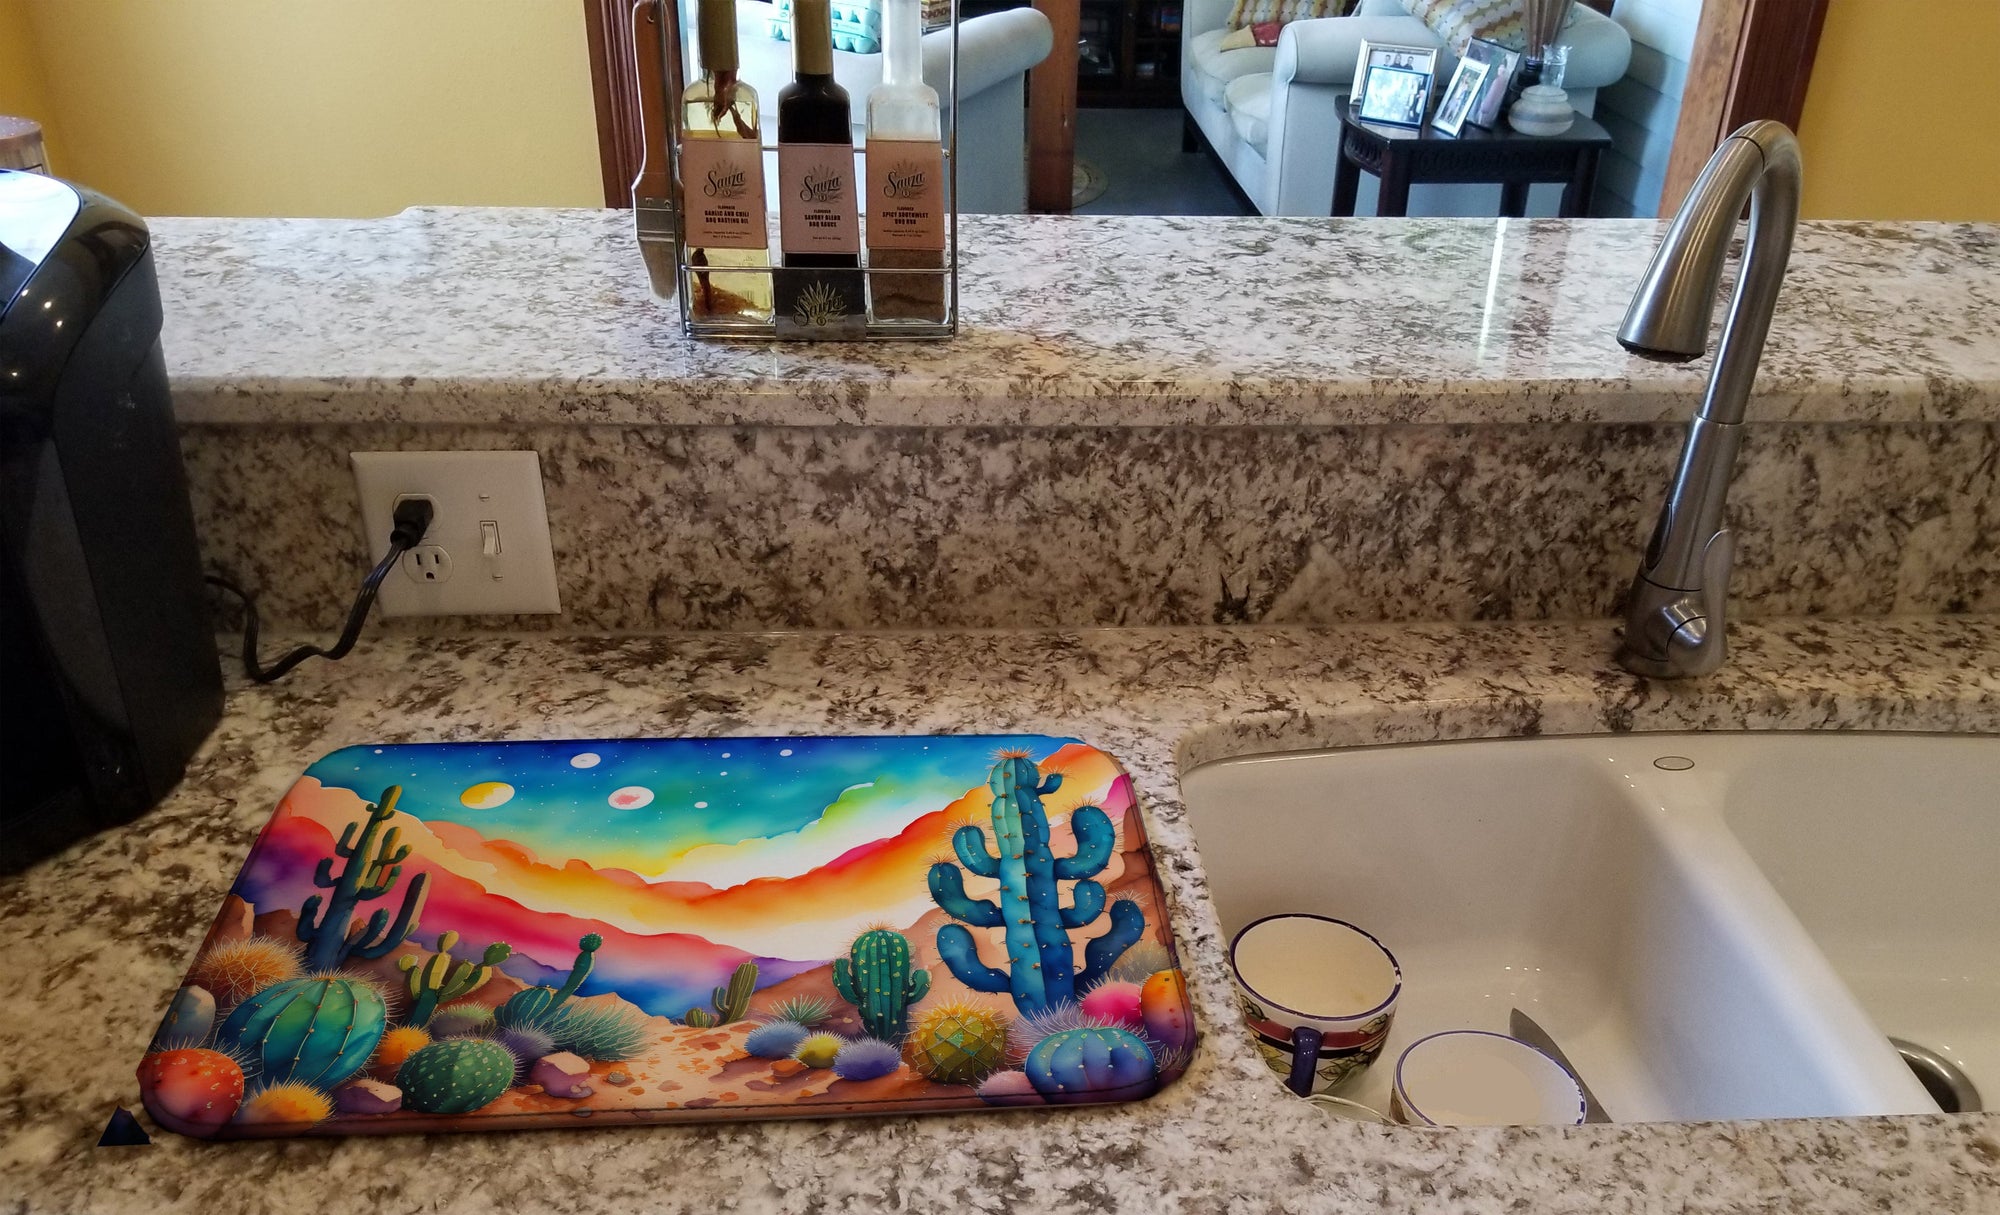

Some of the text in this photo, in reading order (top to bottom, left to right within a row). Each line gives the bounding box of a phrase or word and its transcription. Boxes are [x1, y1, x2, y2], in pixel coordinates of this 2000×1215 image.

[703, 170, 745, 197] Sauza
[800, 175, 841, 202] Sauza
[883, 170, 925, 198] Sauza
[793, 295, 844, 327] Sauza
